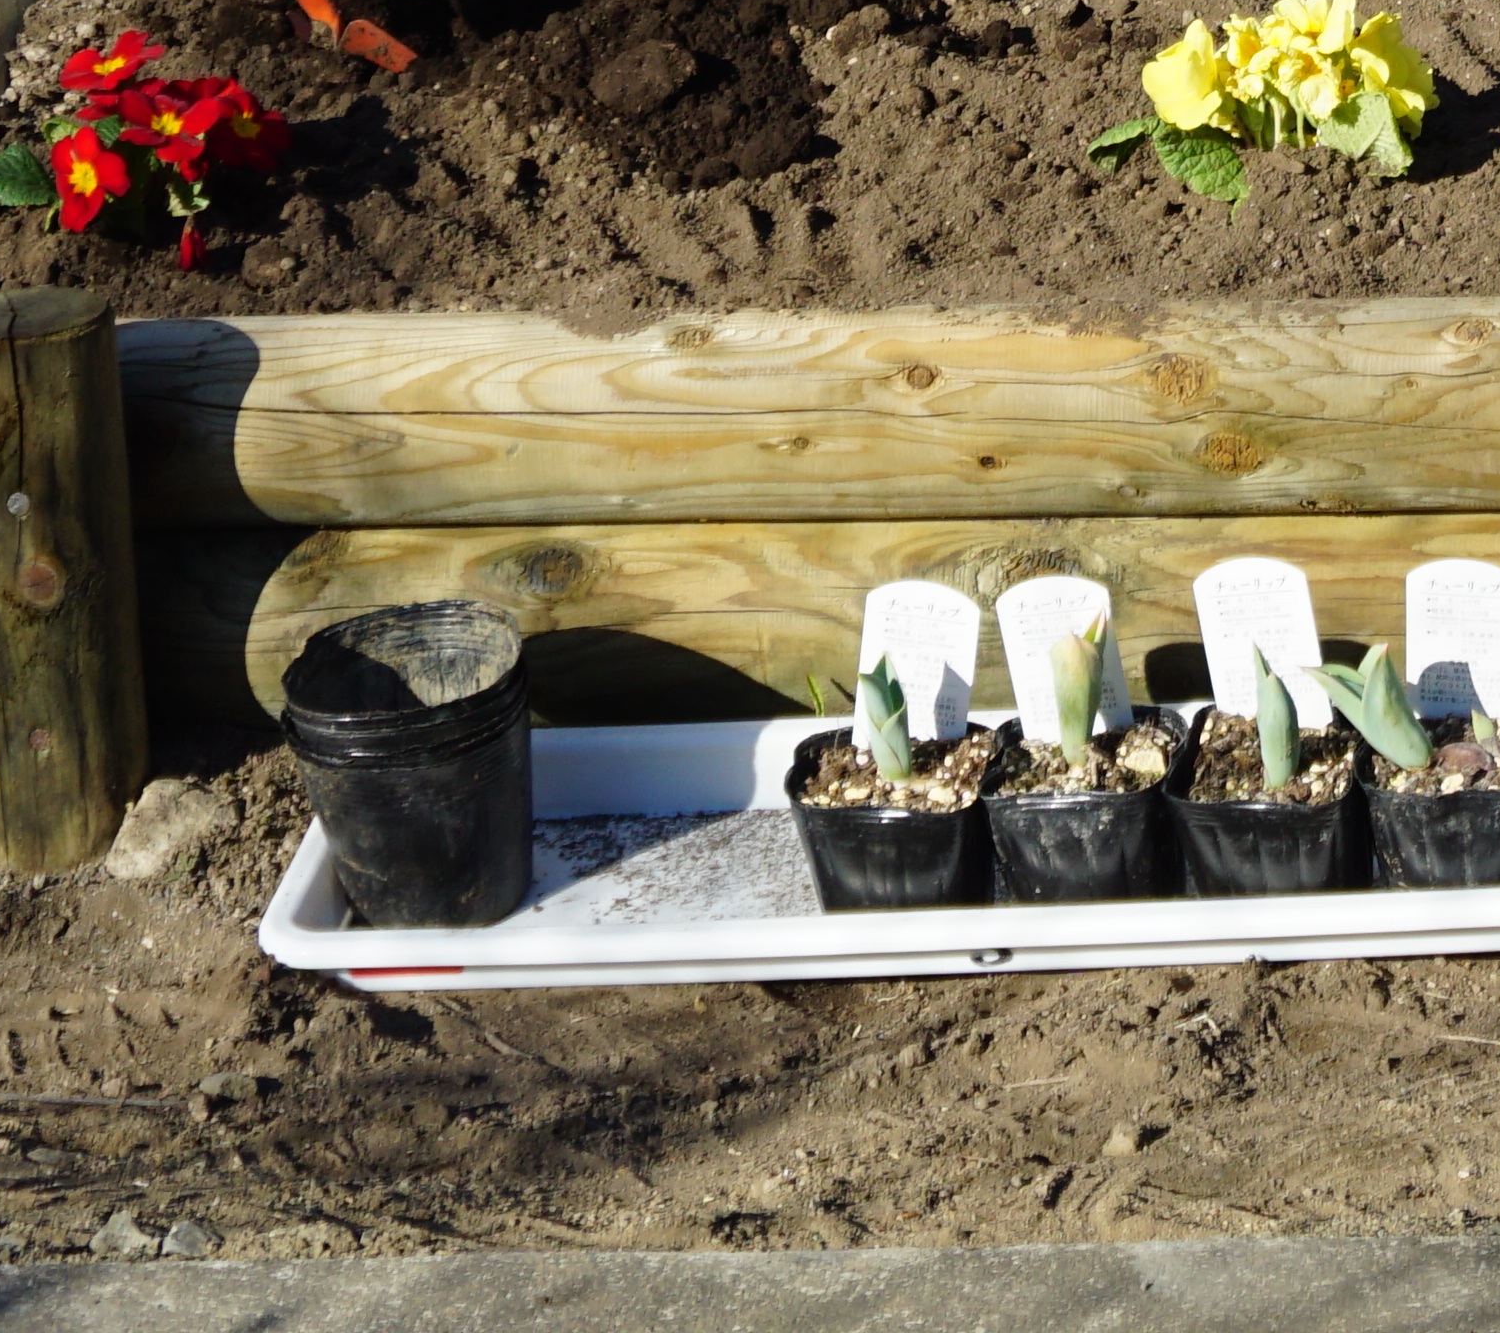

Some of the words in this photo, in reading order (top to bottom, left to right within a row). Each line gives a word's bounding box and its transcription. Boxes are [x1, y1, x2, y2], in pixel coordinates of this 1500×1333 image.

[1215, 574, 1287, 594] チューリップ
[886, 598, 962, 618] チューリップ
[1016, 592, 1088, 613] チューリップ
